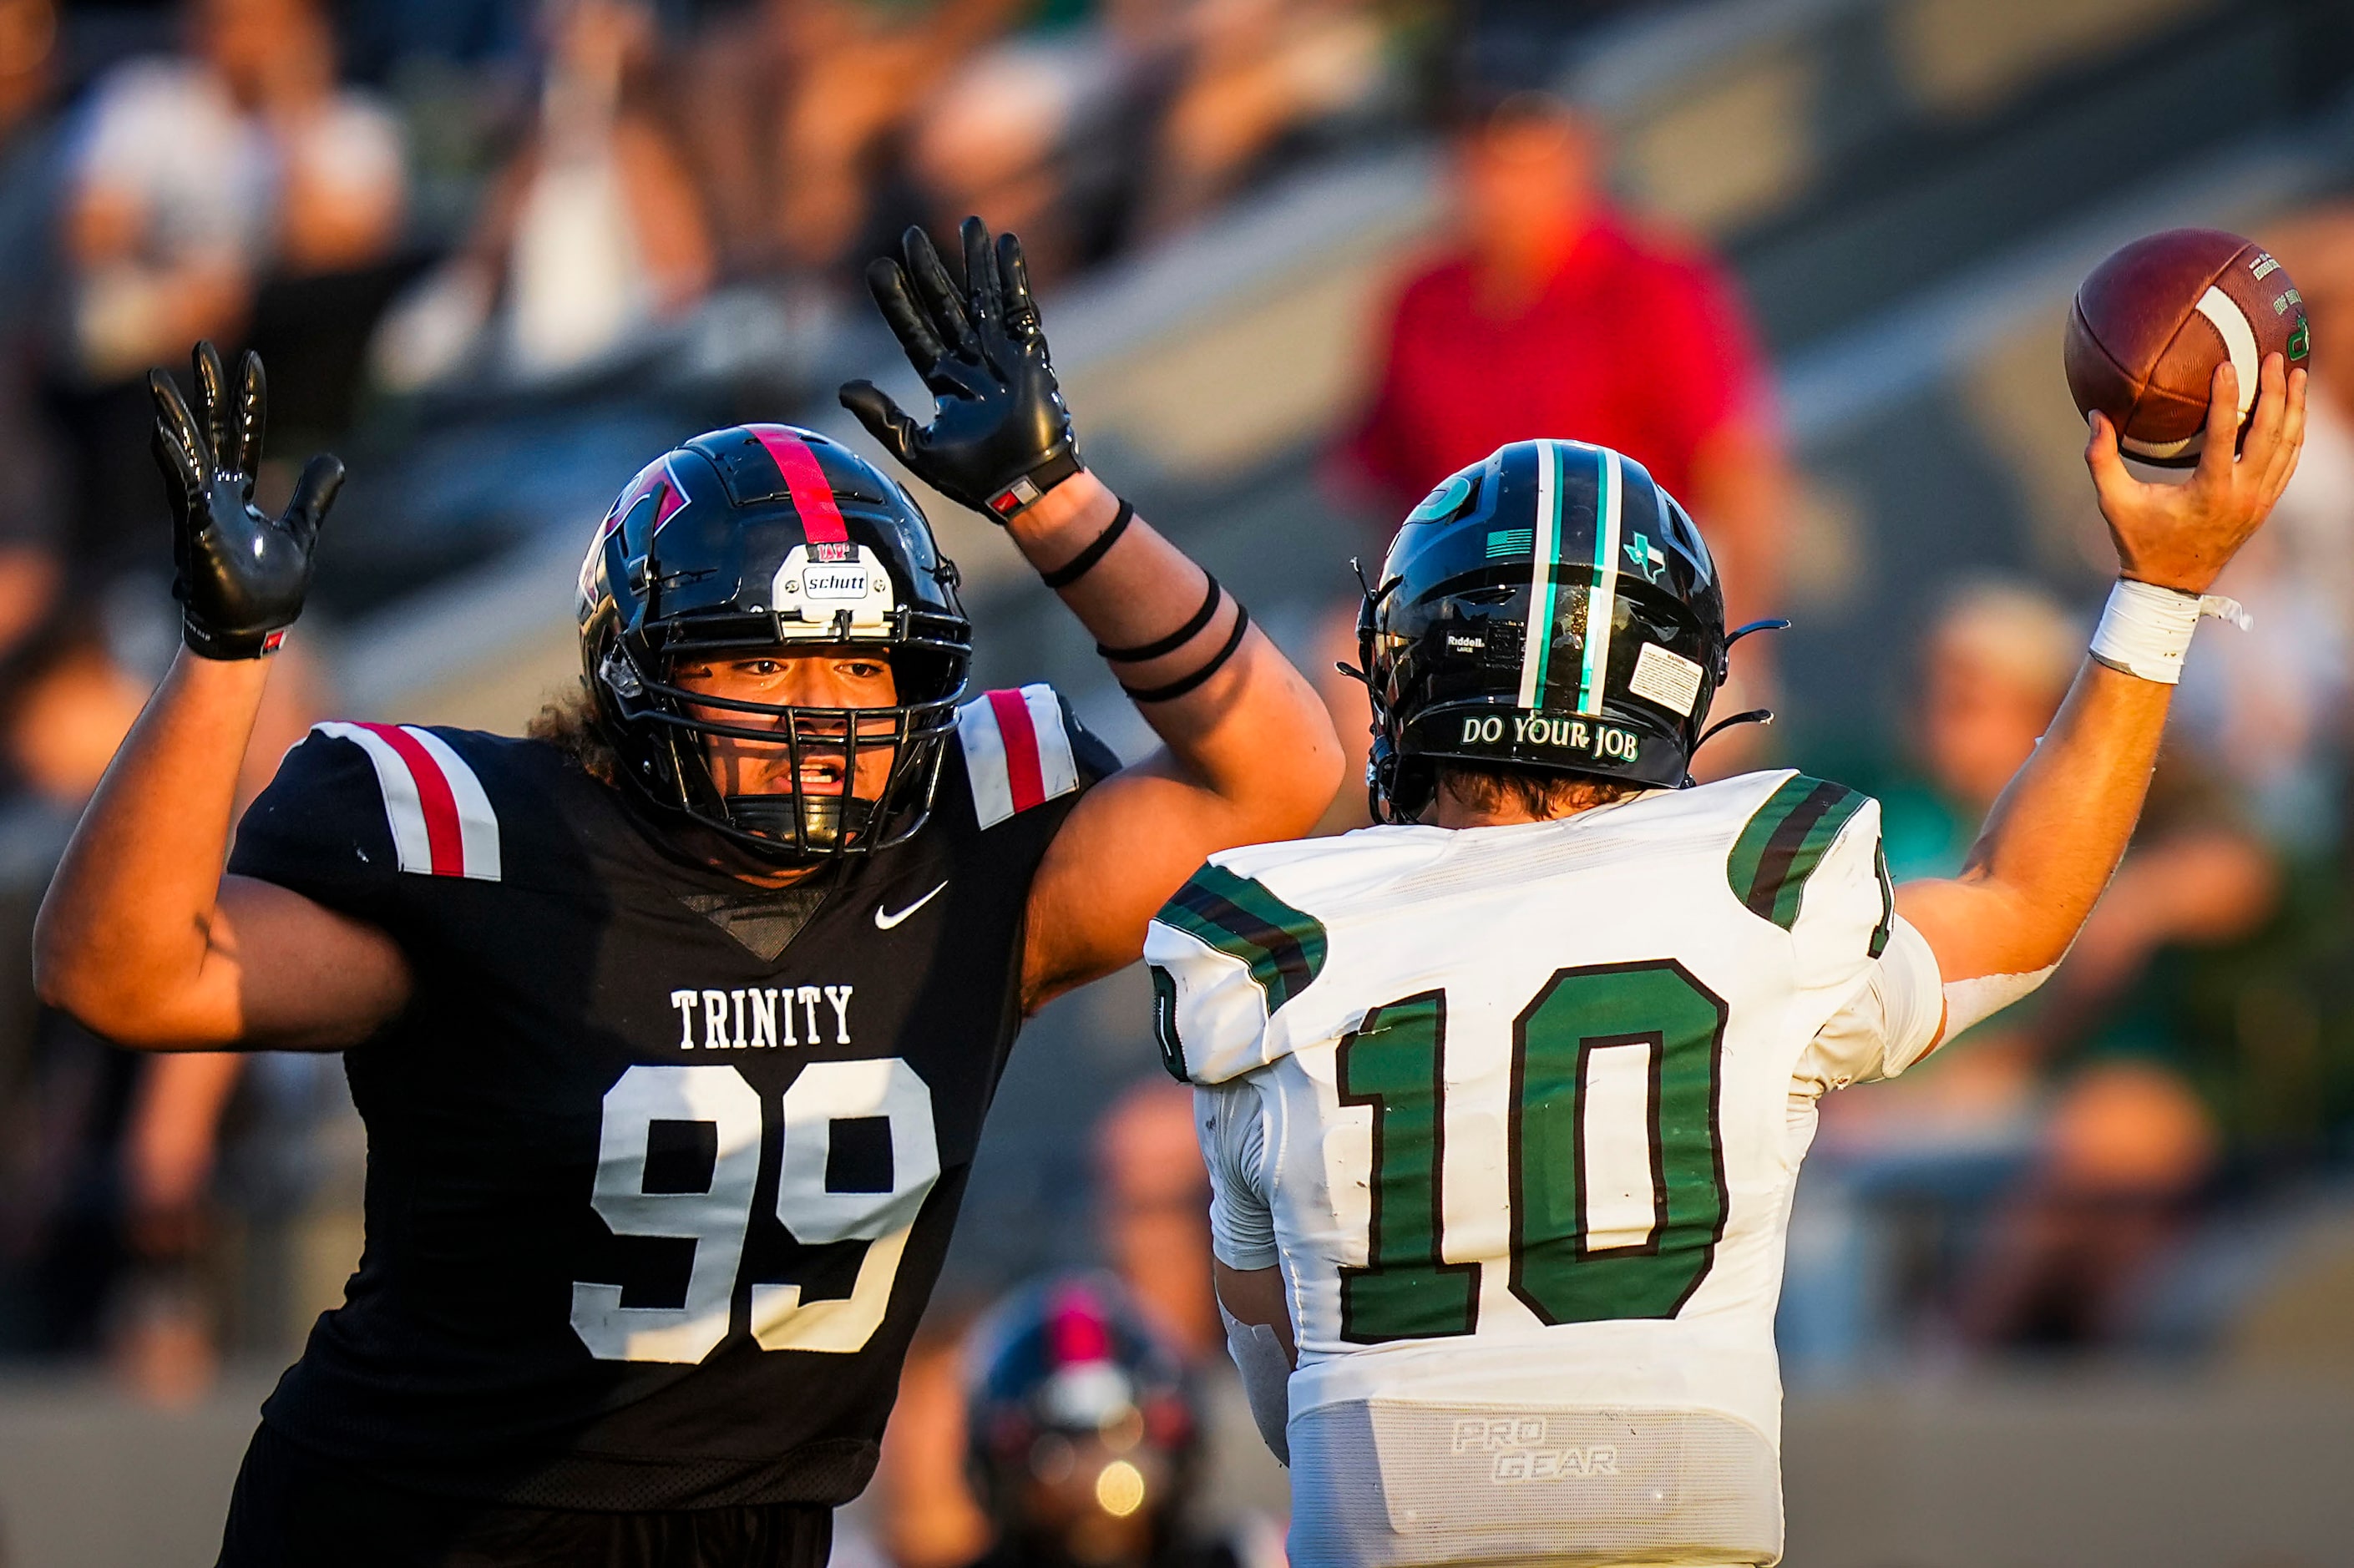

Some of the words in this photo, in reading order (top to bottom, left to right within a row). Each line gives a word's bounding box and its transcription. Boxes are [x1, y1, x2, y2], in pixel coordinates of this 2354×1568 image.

[808, 574, 865, 590] schutt
[1447, 635, 1483, 647] Riddell
[1461, 716, 1504, 744] DO
[1514, 716, 1591, 749] YOUR
[1593, 725, 1638, 761] JOB
[669, 984, 855, 1050] TRINITY
[1336, 958, 1729, 1343] 10
[570, 1057, 941, 1366] 99
[1452, 1417, 1547, 1454] PRO
[1492, 1445, 1619, 1485] GEAR
